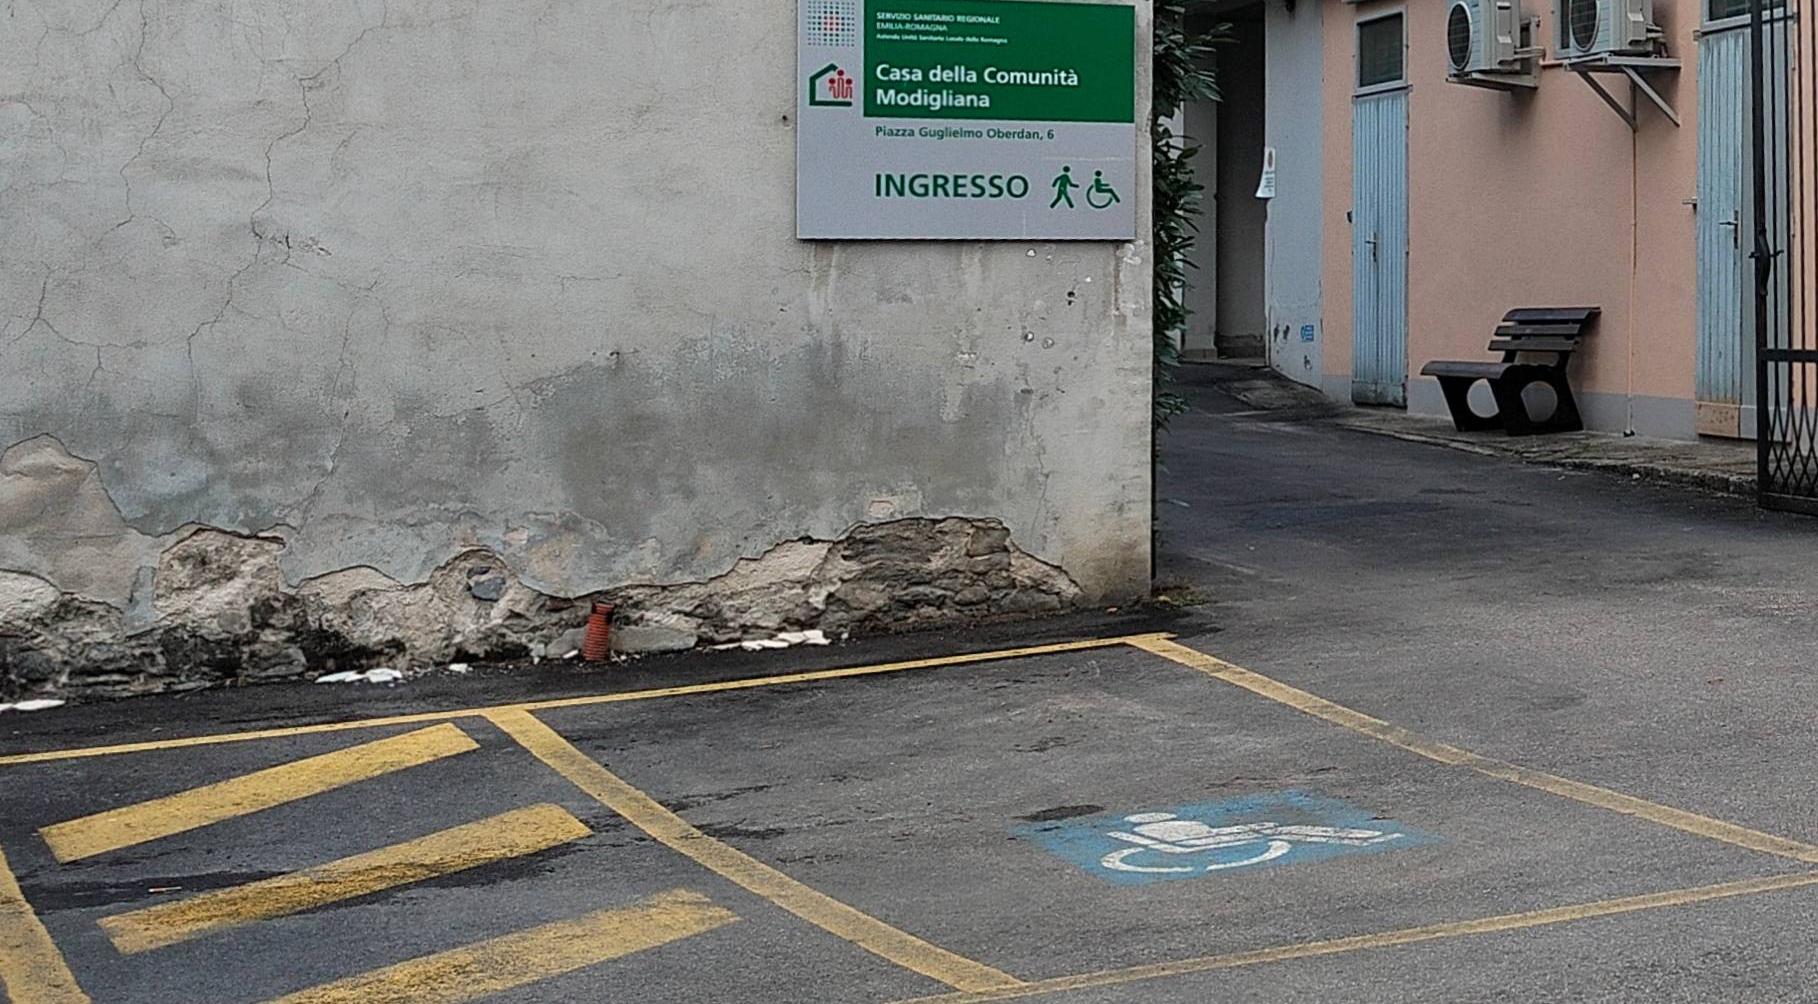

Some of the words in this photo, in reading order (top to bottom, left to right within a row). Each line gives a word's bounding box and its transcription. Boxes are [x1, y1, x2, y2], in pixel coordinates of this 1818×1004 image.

[876, 11, 912, 20] SERVIZIO
[913, 13, 955, 22] SANITARIO
[956, 14, 1000, 24] REGIONALE
[876, 22, 948, 32] EMILIA-ROMAGNA
[876, 64, 923, 82] Casa
[928, 64, 977, 84] della
[983, 67, 1078, 86] Comunità
[876, 89, 990, 111] Modigliana
[875, 125, 915, 138] Piazza
[918, 126, 983, 142] Guglielmo
[986, 127, 1044, 141] Oberdan,
[1047, 128, 1055, 140] 6
[875, 173, 1029, 199] INGRESSO
